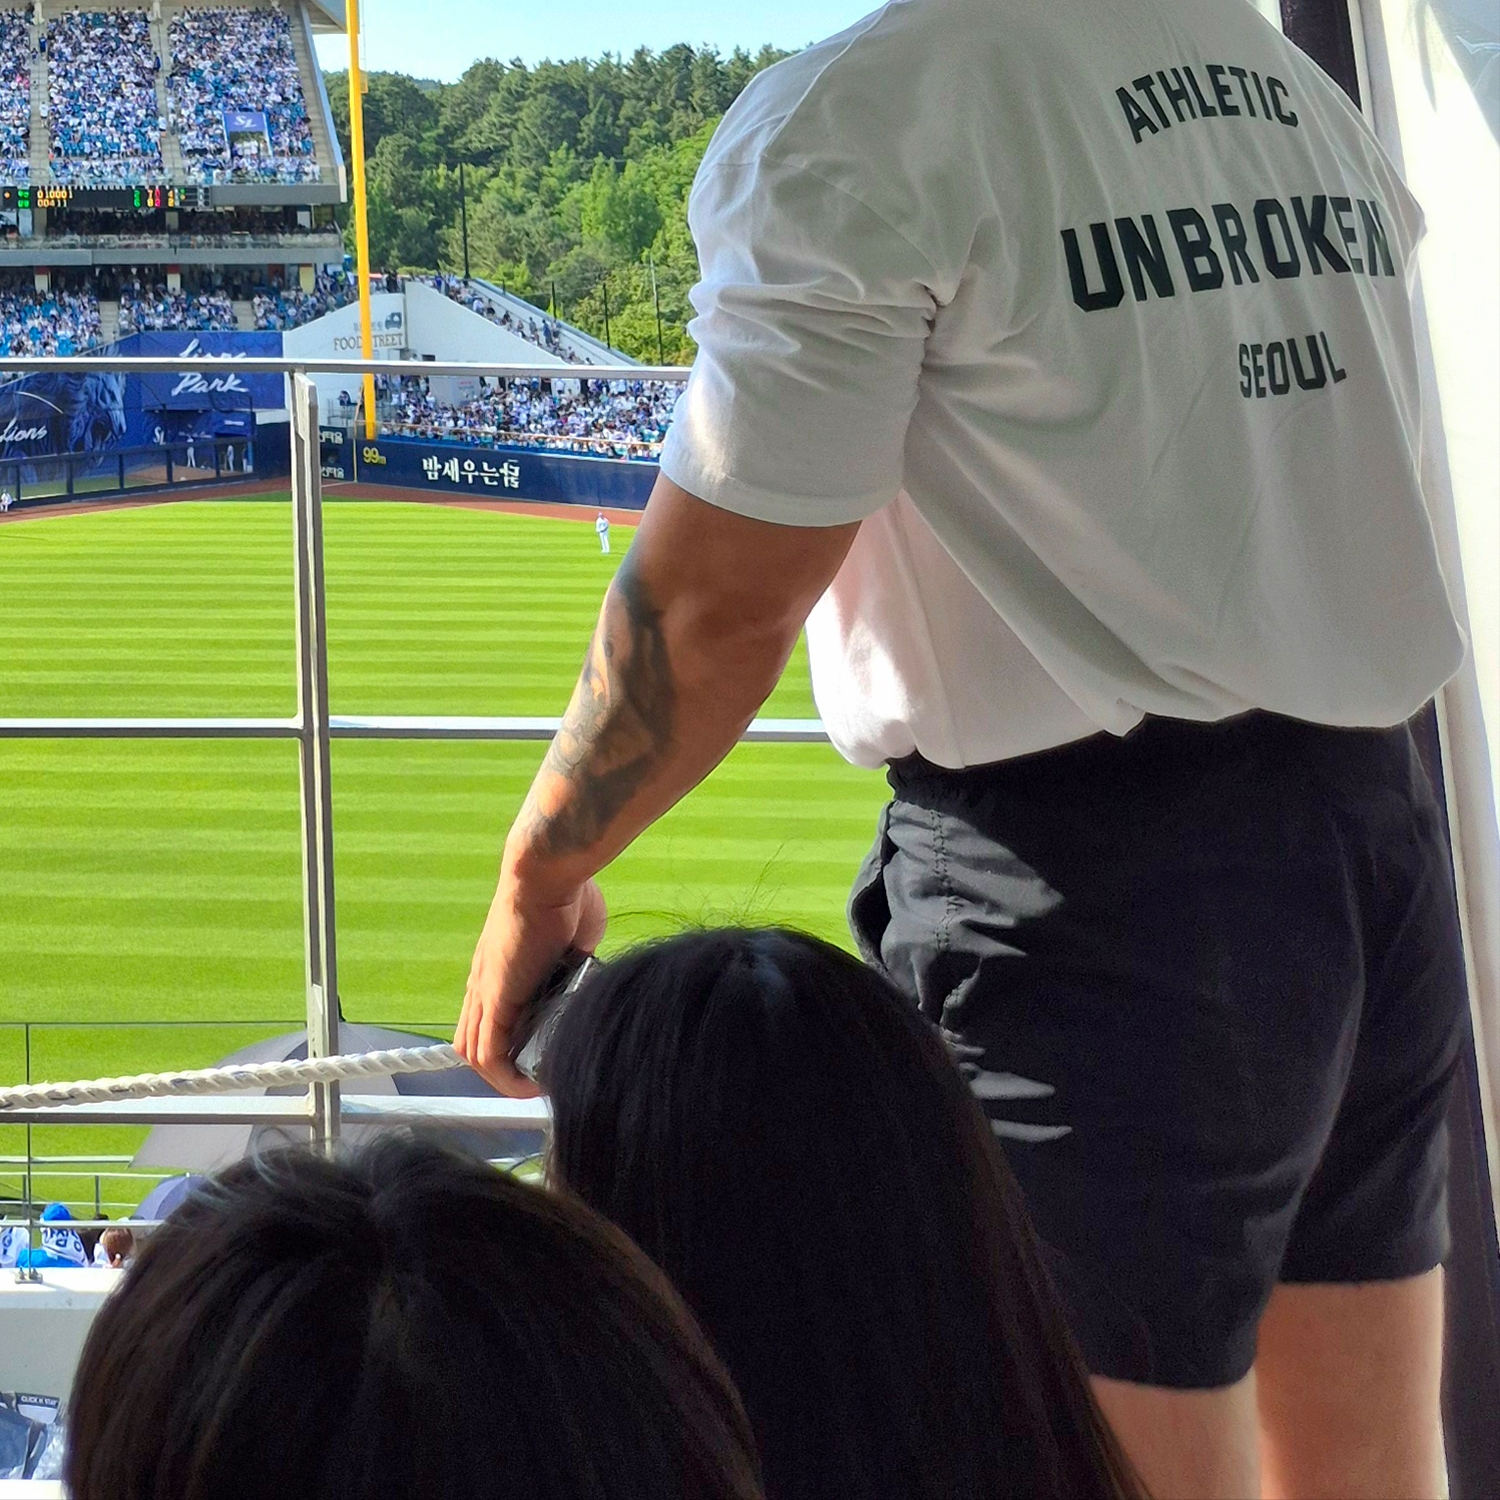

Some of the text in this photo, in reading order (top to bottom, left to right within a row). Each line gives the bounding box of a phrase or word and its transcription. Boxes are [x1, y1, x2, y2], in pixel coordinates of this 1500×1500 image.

[1115, 64, 1299, 144] ATHLETIC
[1060, 194, 1396, 313] UNBROKEN
[372, 333, 403, 348] TREET
[1238, 331, 1347, 399] SEOUL
[171, 373, 250, 397] Park
